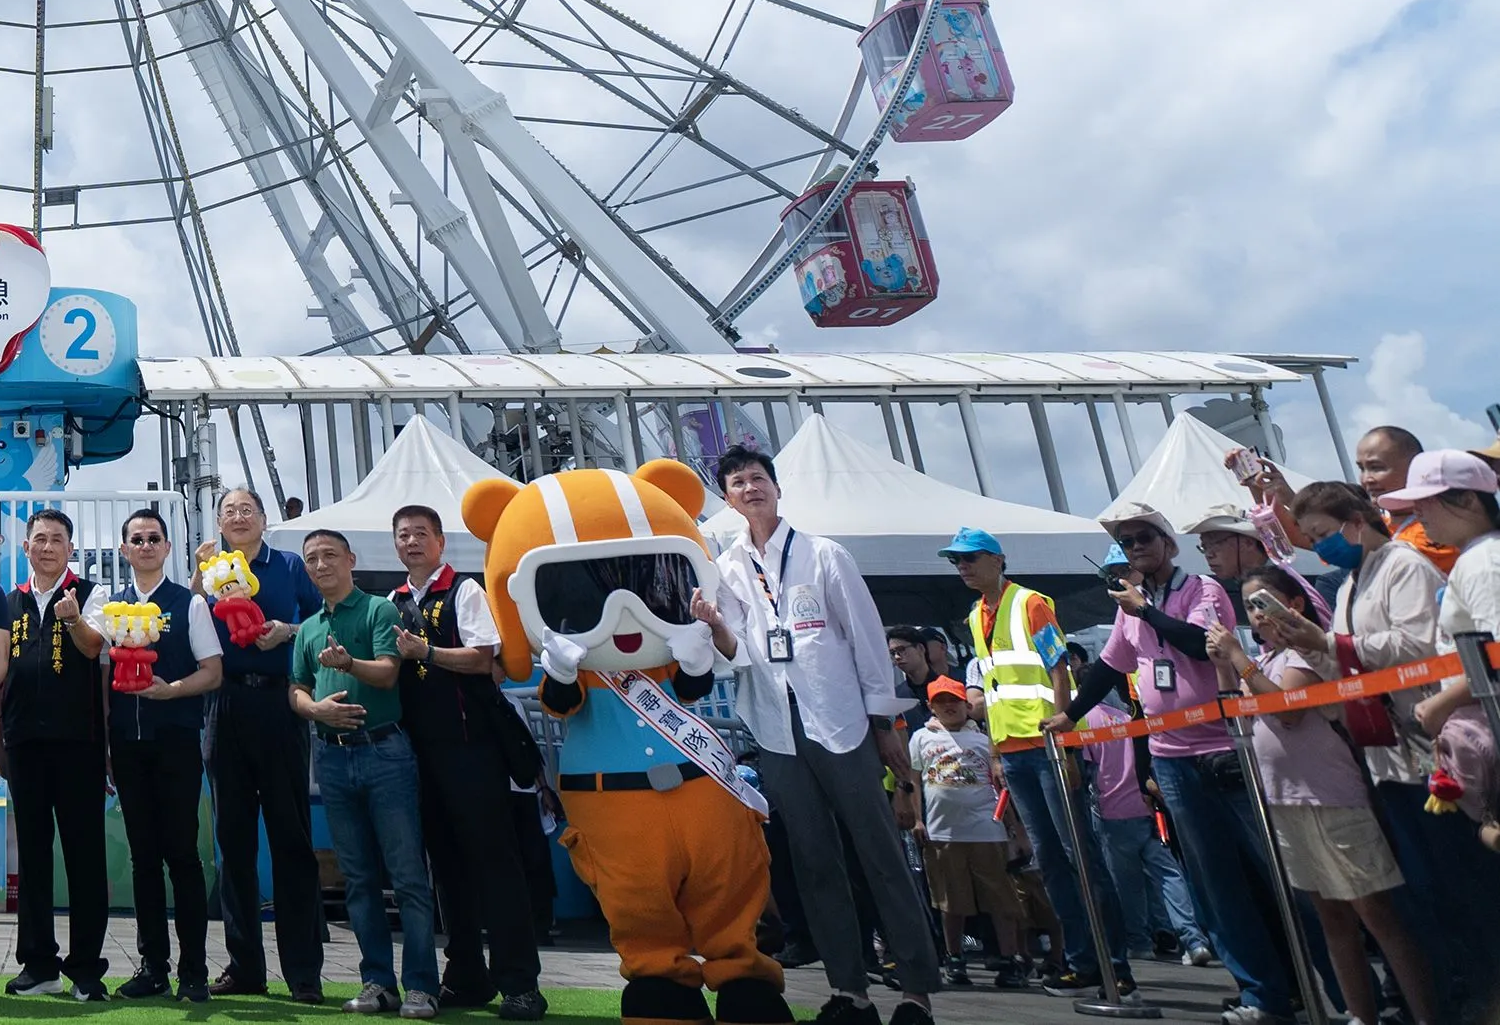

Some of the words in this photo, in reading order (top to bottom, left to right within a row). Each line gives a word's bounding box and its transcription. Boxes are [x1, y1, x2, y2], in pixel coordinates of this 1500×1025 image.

[922, 114, 984, 130] 27
[849, 307, 902, 319] 01
[63, 308, 100, 360] 2
